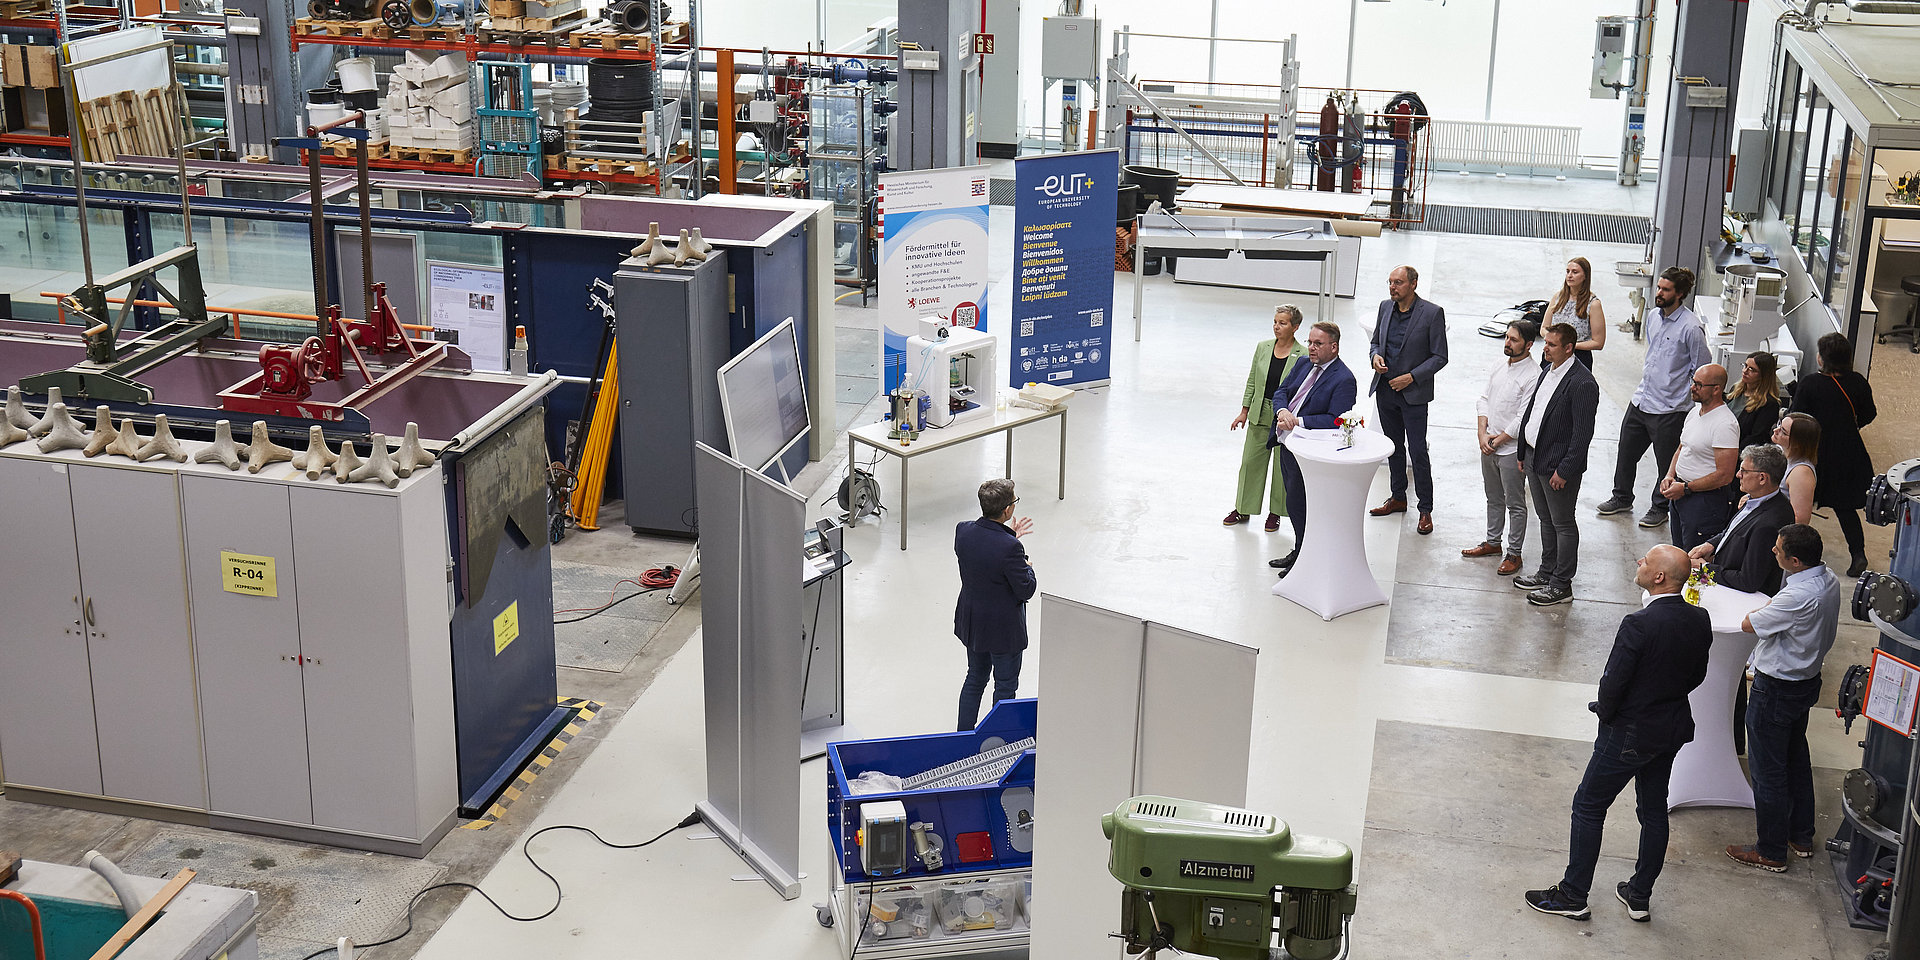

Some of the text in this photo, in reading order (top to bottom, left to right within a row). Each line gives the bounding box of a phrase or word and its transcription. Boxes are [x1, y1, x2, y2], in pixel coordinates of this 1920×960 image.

[1024, 233, 1053, 241] Welcome
[905, 242, 949, 253] Fördermittel
[1023, 241, 1058, 250] Bienvenue
[905, 251, 942, 260] innovative
[1023, 248, 1063, 258] Bienvenidos
[1023, 257, 1064, 267] Willkommen
[912, 270, 939, 278] angewandte
[1022, 265, 1068, 277] Добре дошли
[912, 276, 961, 285] Kooperationsprojekte
[1022, 276, 1037, 284] Bine
[1049, 272, 1066, 281] venit
[1022, 282, 1056, 293] Benvenuti
[919, 297, 940, 305] LOEWE
[1022, 292, 1042, 302] Laipni
[228, 558, 266, 566] VERSUCHSRINNE
[233, 567, 264, 580] R-04
[1184, 862, 1250, 879] Alzmetall
